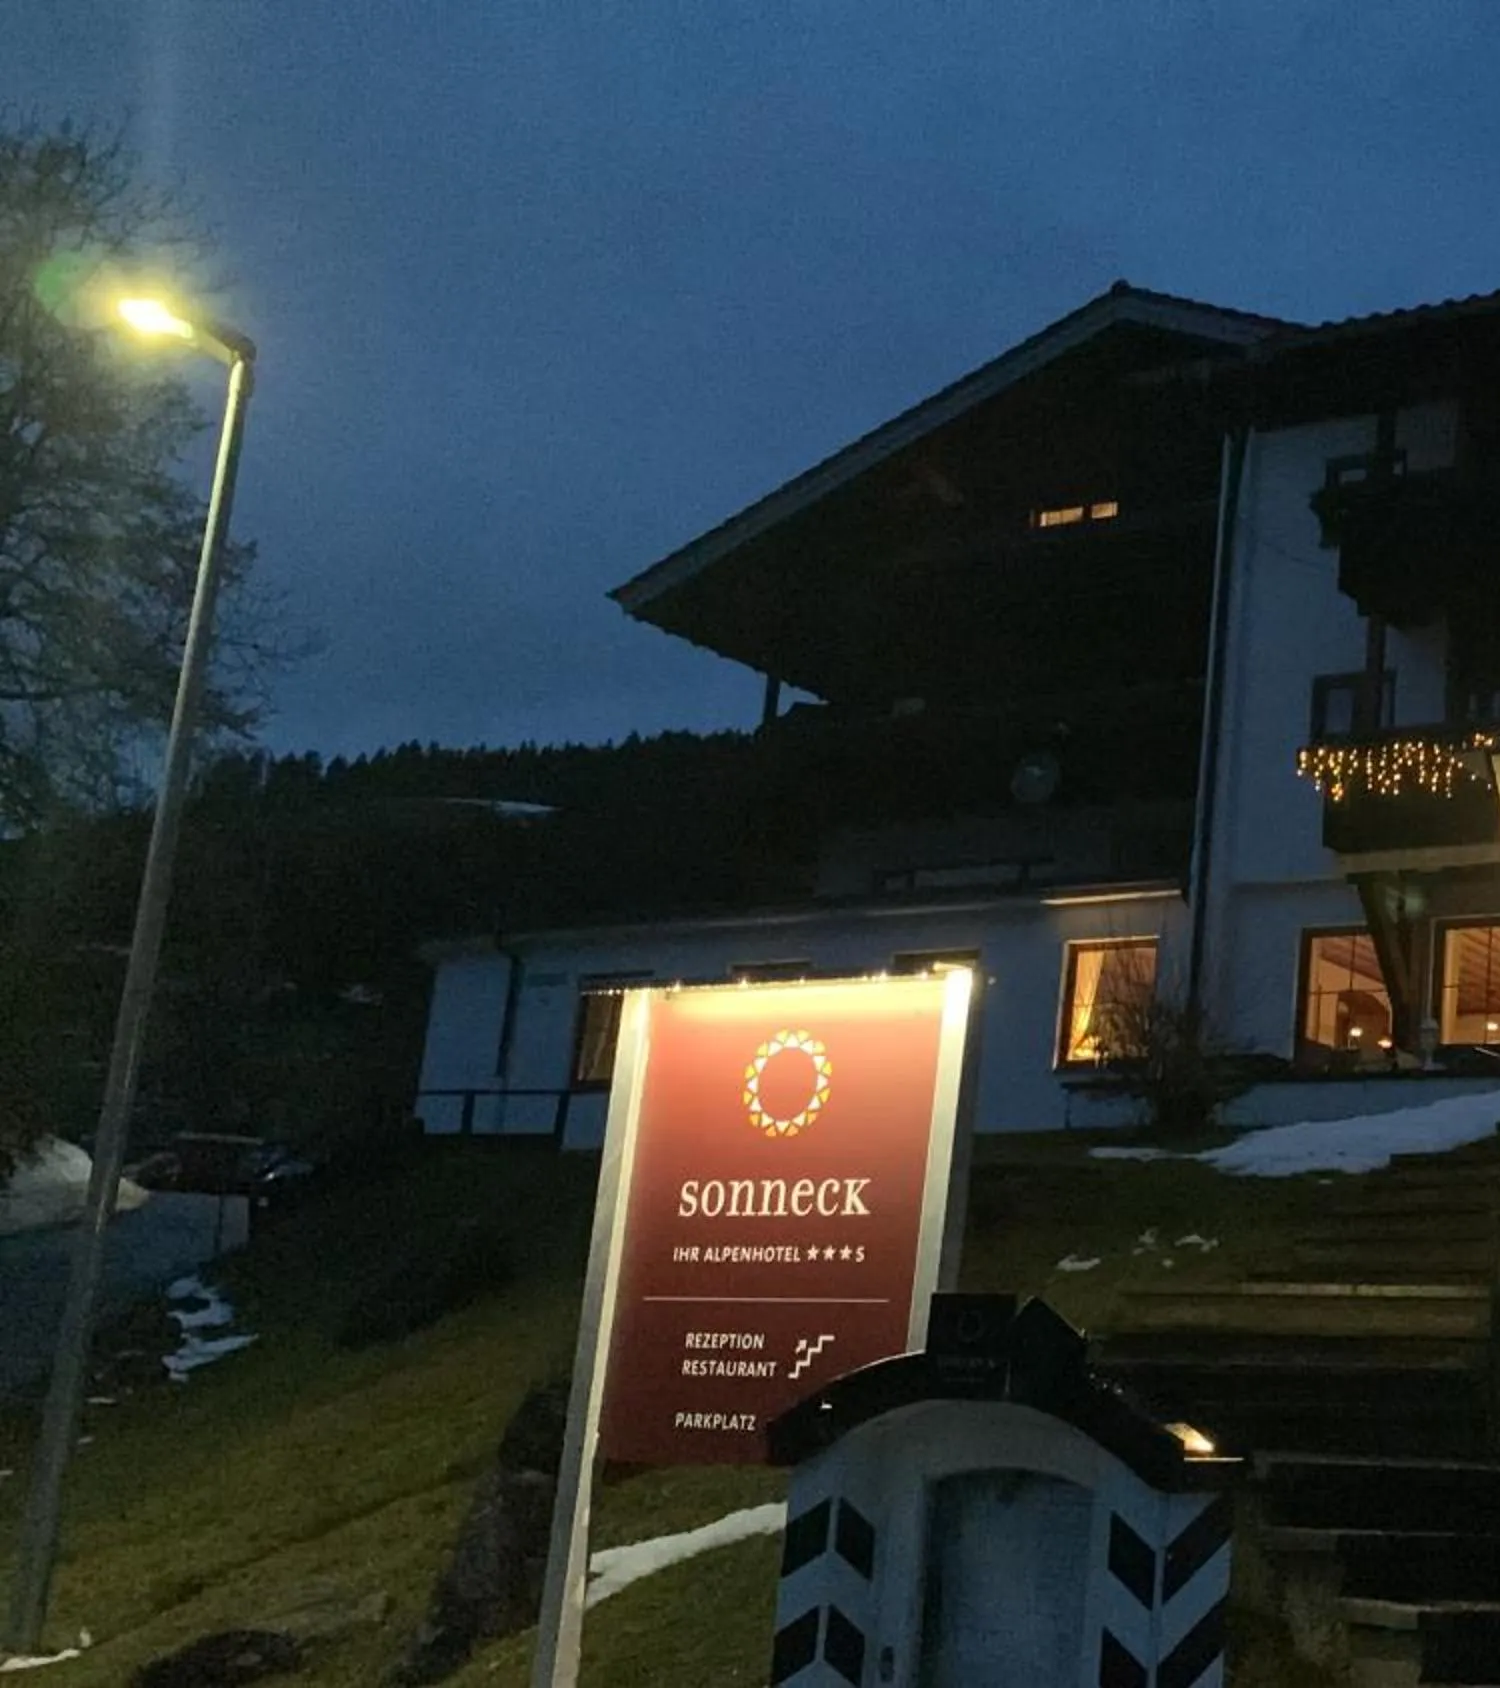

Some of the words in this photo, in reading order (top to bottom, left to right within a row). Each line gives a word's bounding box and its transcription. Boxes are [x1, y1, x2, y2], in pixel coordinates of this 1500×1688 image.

[673, 1246, 700, 1263] IHR
[703, 1246, 801, 1263] ALPENHOTEL
[684, 1332, 766, 1350] REZEPTION
[681, 1359, 778, 1378] RESTAURANT
[674, 1411, 757, 1431] PARKPLATZ
